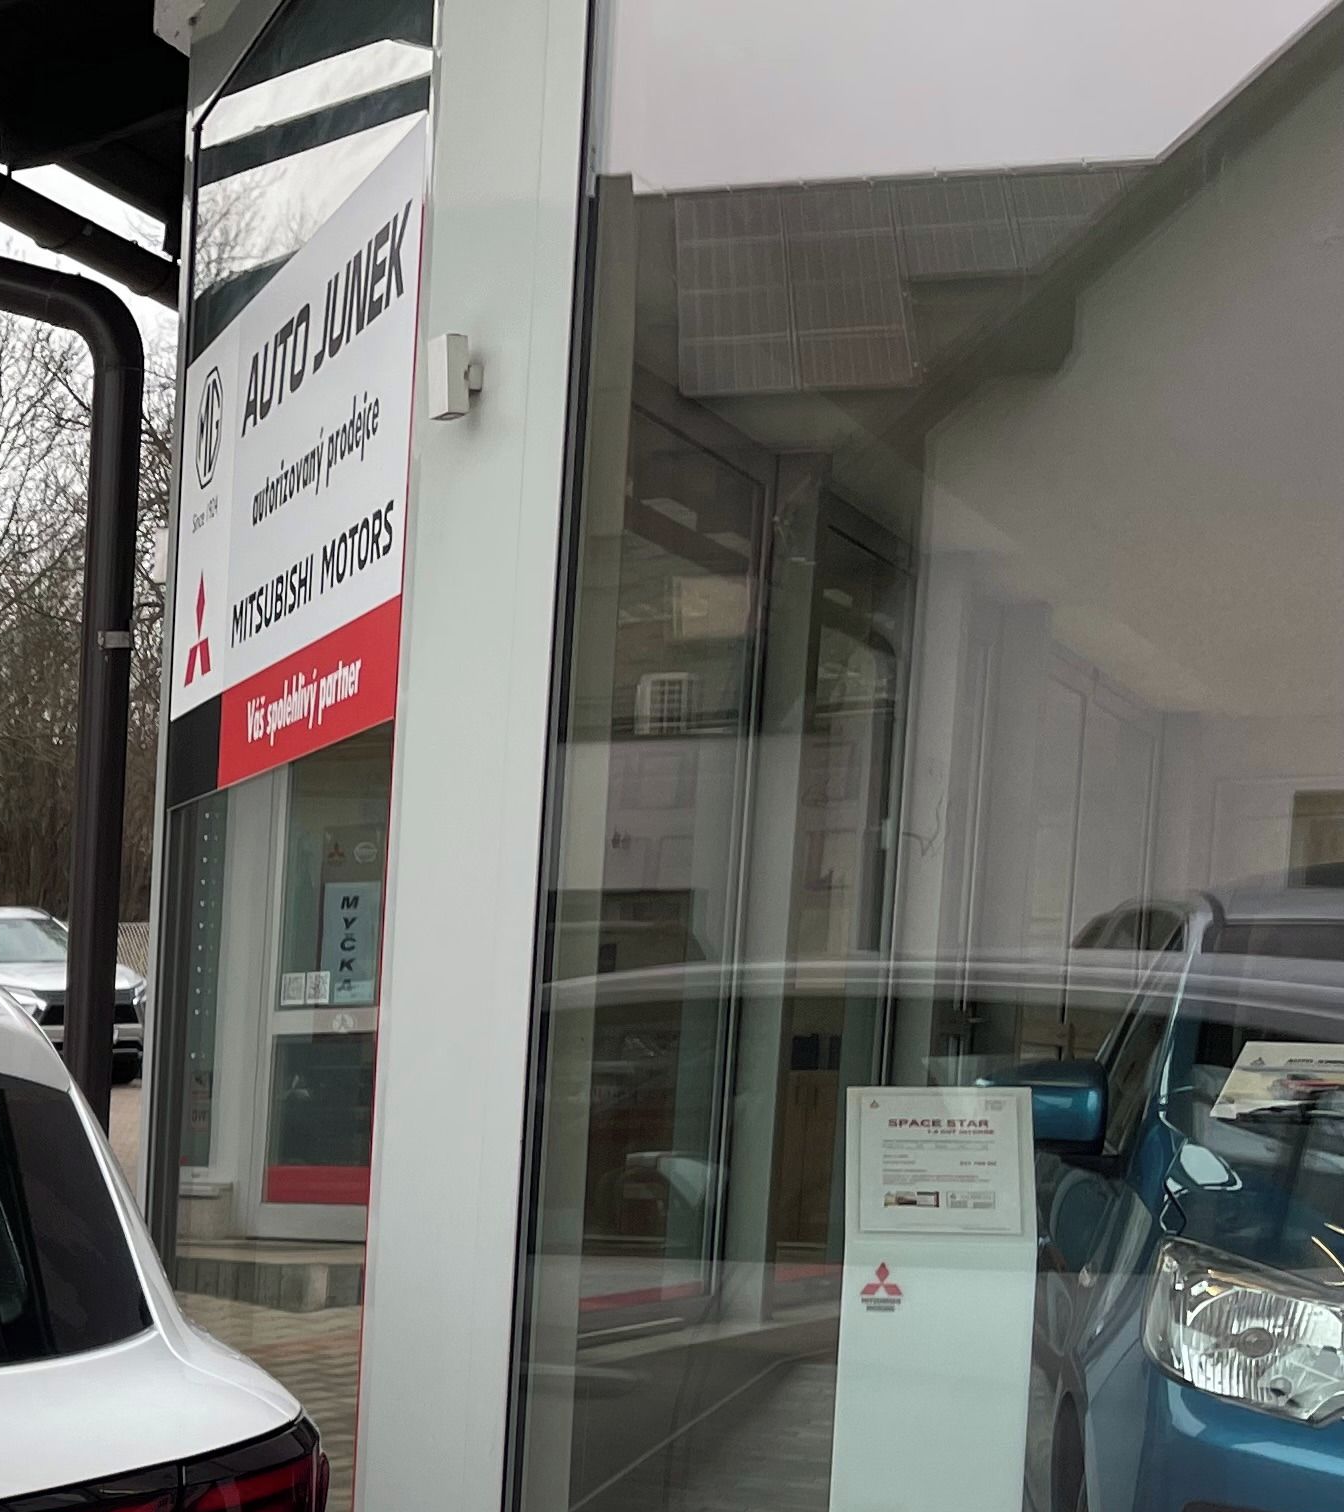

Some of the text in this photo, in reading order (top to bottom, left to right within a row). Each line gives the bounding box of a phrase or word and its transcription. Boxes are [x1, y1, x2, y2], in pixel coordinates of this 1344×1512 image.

[241, 198, 412, 438] AUTO JUNEK
[197, 374, 222, 480] MG
[252, 390, 380, 527] autorizovaný prodejce
[231, 499, 394, 648] MITSUBISHI MOTORS
[247, 659, 362, 747] Váš spolehlivý partner
[888, 1118, 989, 1129] SPACE STAR
